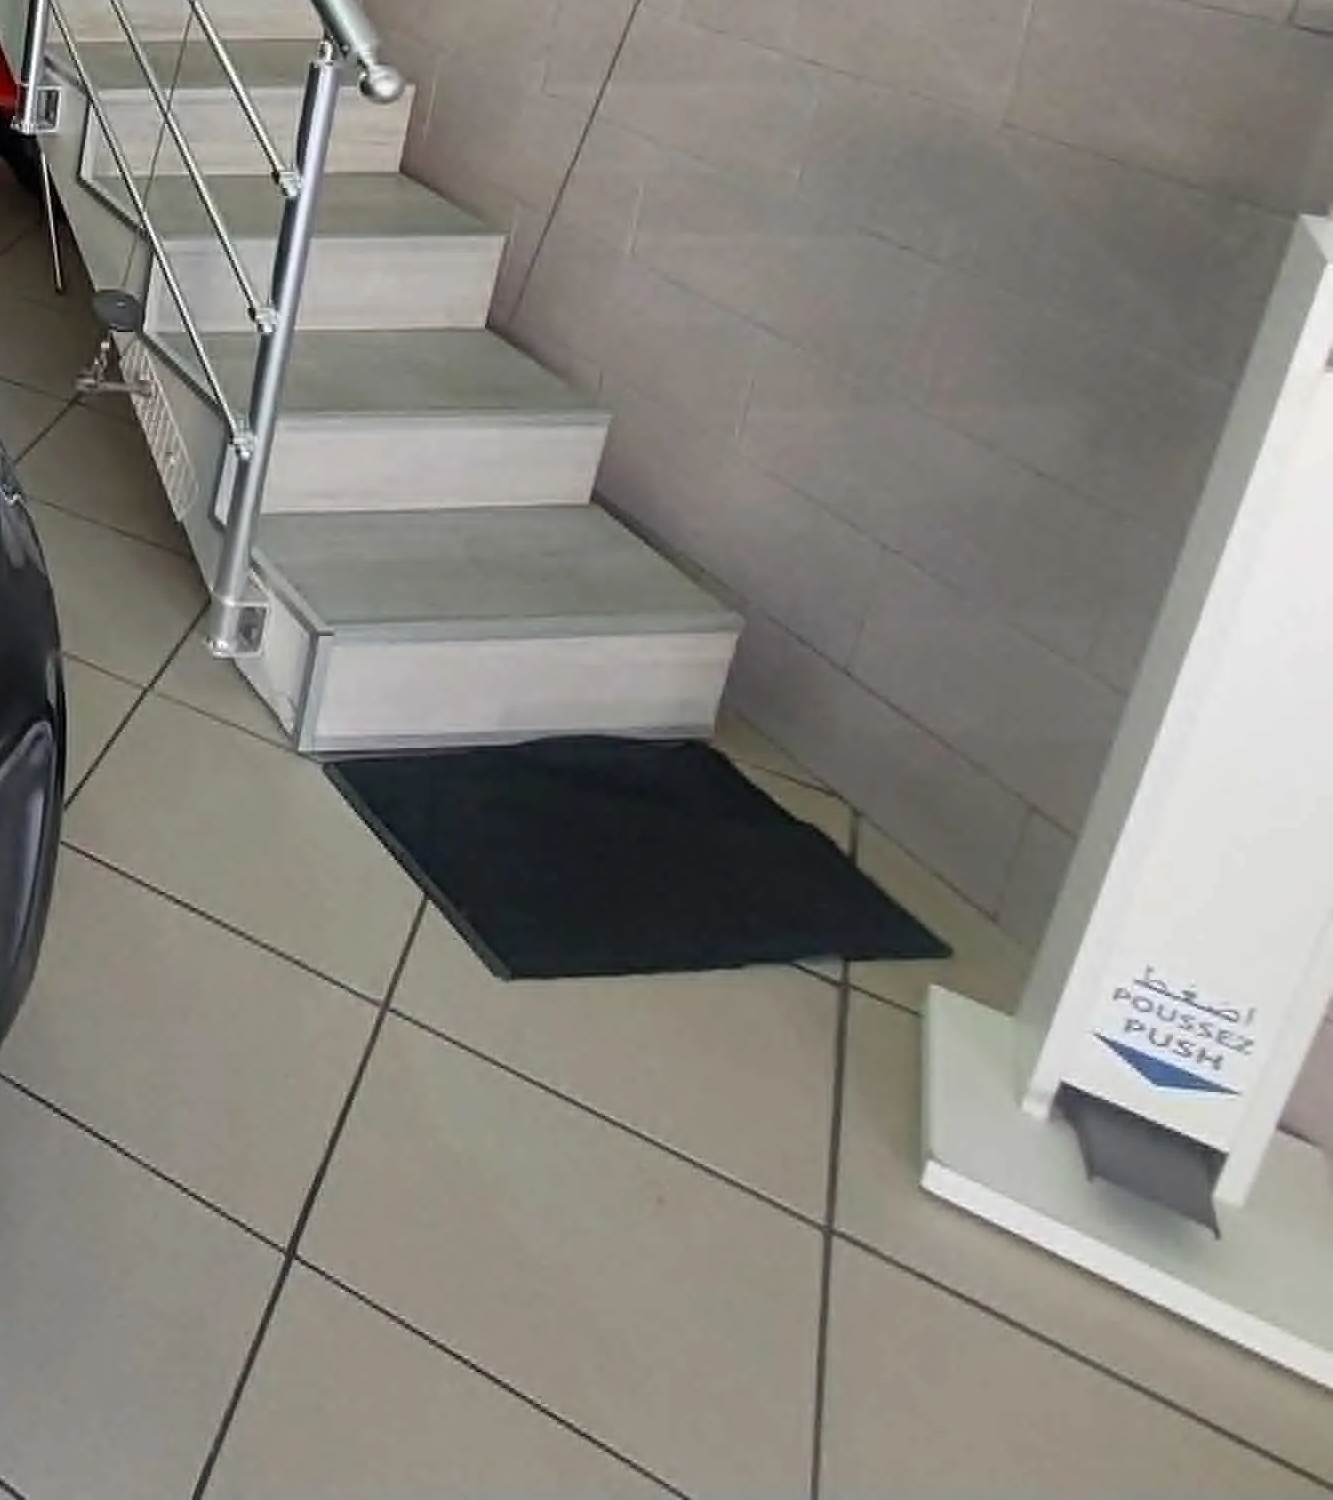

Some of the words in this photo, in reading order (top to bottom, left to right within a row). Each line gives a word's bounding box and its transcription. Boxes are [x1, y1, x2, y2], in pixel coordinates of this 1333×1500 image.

[1112, 986, 1255, 1056] POUSSEZ
[1133, 964, 1257, 1027] اضغط
[1123, 1018, 1225, 1071] PUSH
